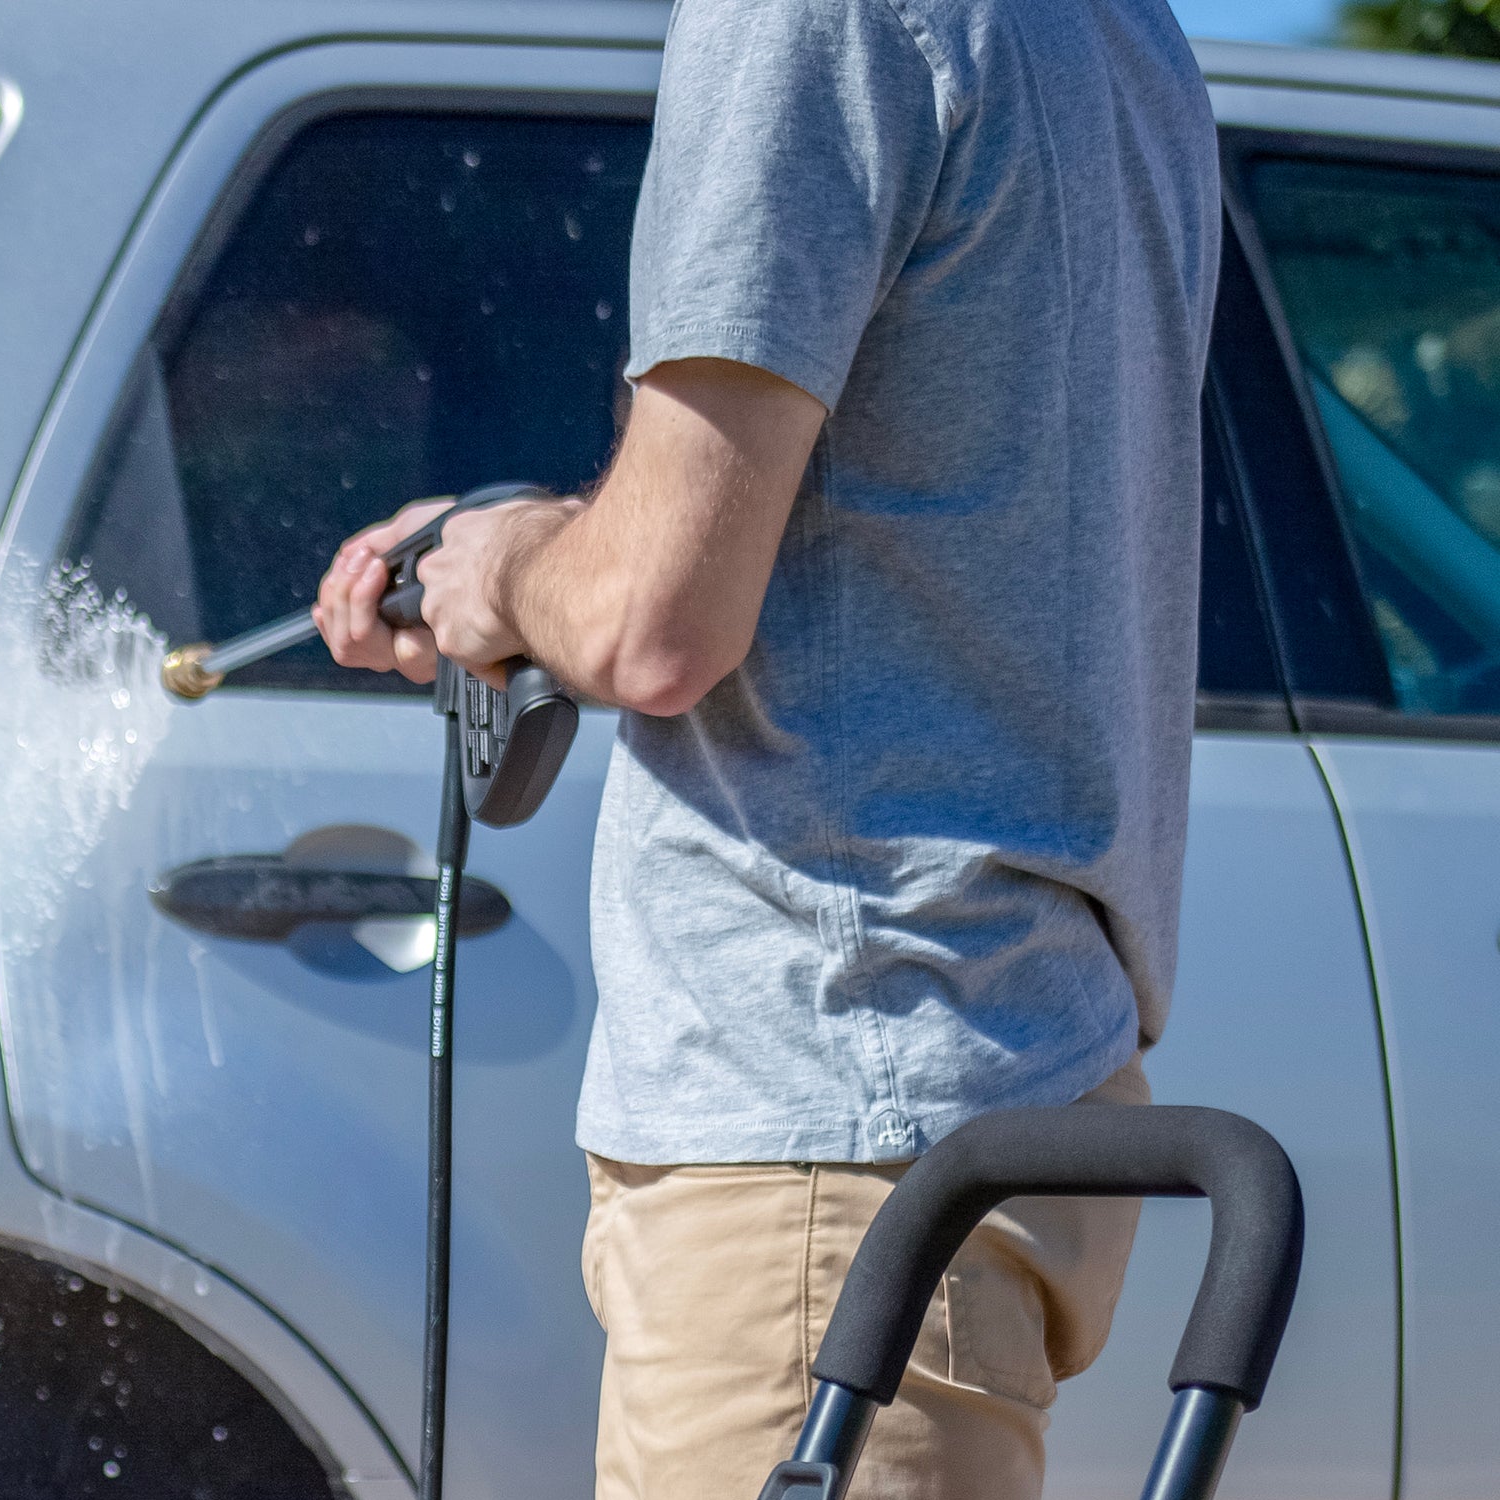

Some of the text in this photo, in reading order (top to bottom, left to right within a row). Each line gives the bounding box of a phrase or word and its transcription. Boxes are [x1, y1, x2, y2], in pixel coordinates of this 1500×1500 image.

[432, 866, 451, 1057] SUNJOE HIGH PRESSURE HOSE
